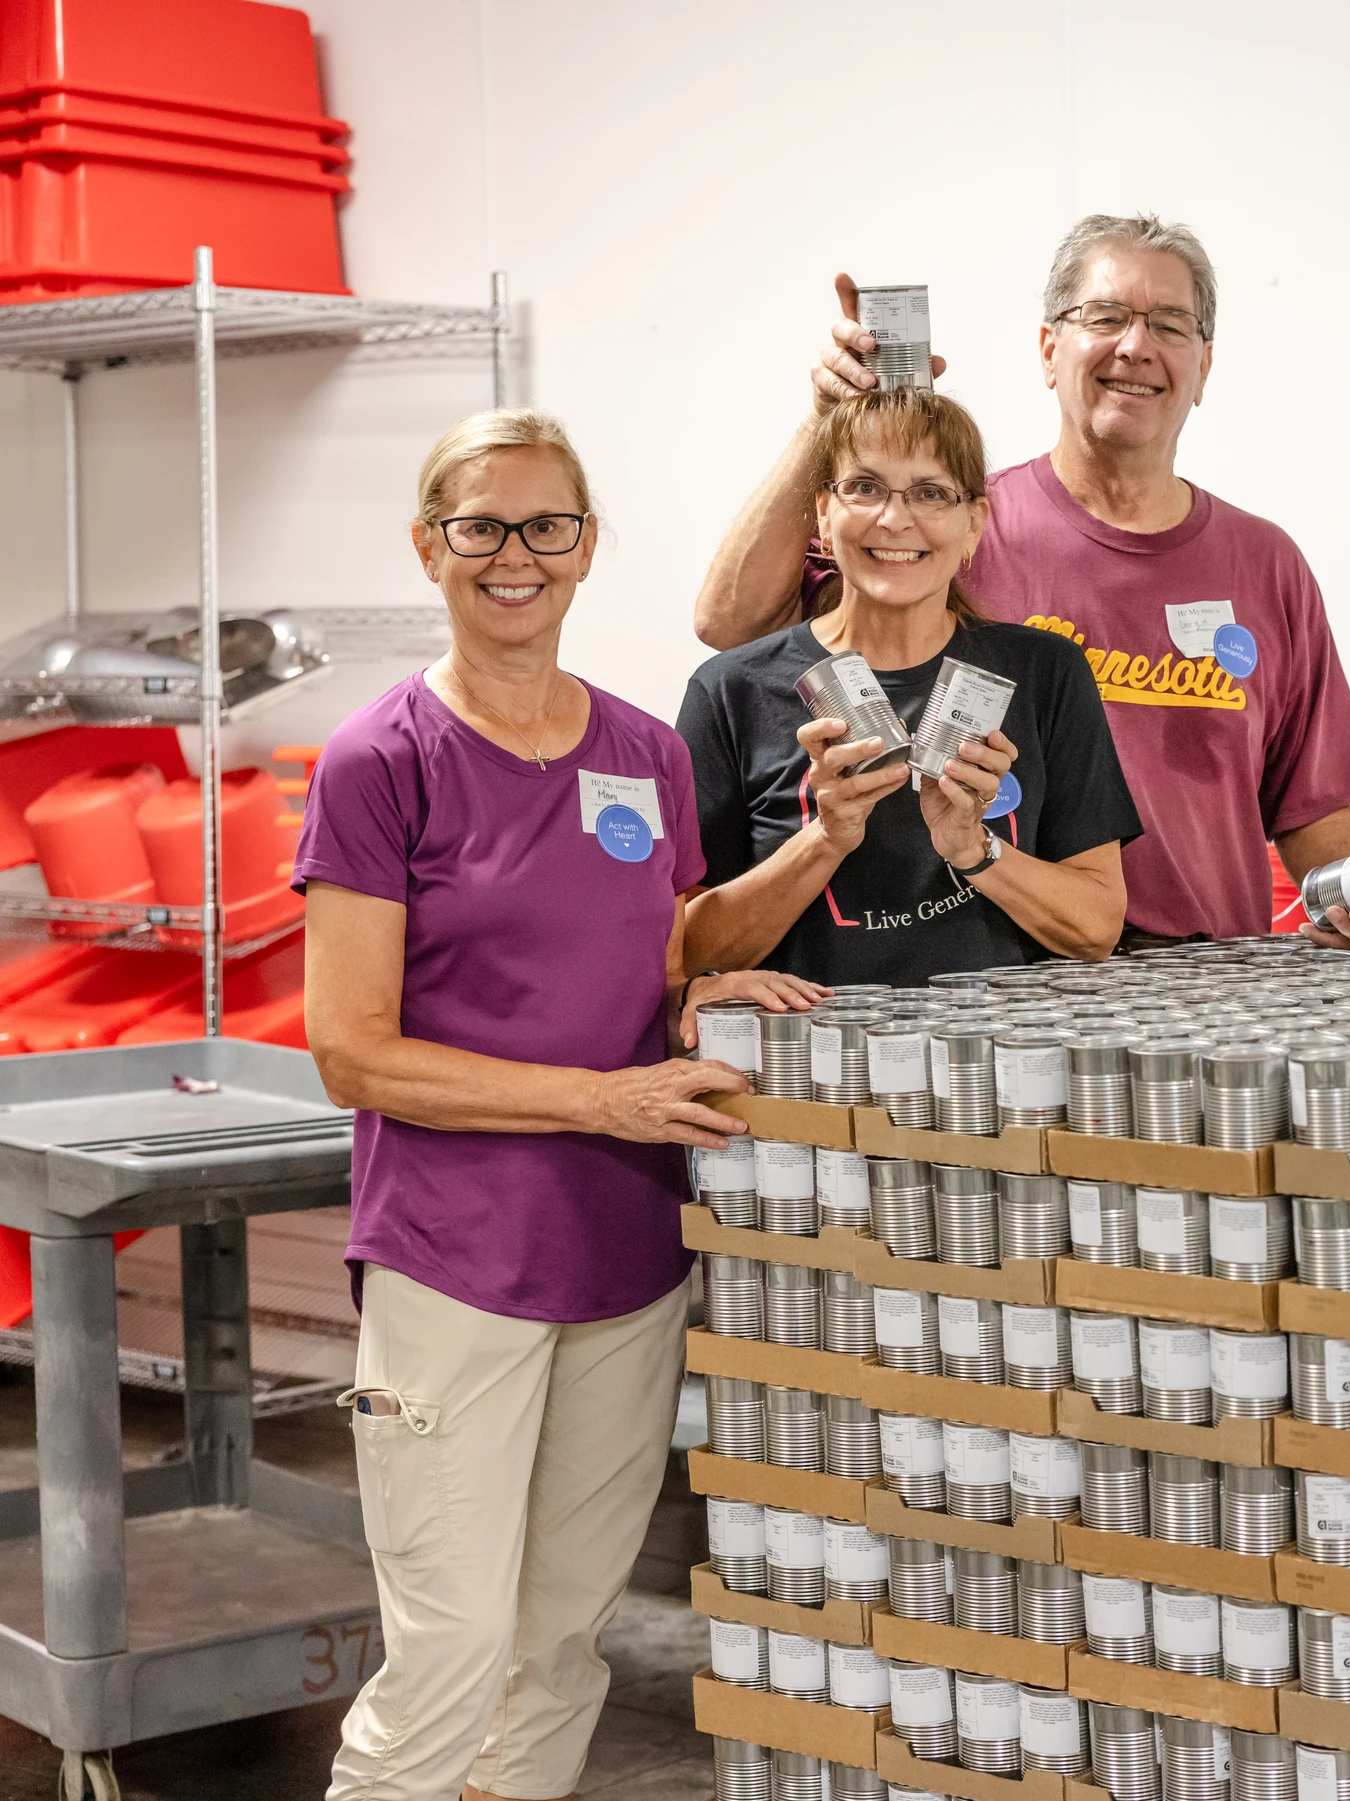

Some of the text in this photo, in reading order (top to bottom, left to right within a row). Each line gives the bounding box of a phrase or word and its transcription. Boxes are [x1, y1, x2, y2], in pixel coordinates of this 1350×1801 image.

[1023, 614, 1247, 704] nnesota
[608, 821, 640, 832] Act with
[614, 831, 636, 840] Heart
[863, 884, 980, 930] Live Gener
[302, 1624, 384, 1695] 37
